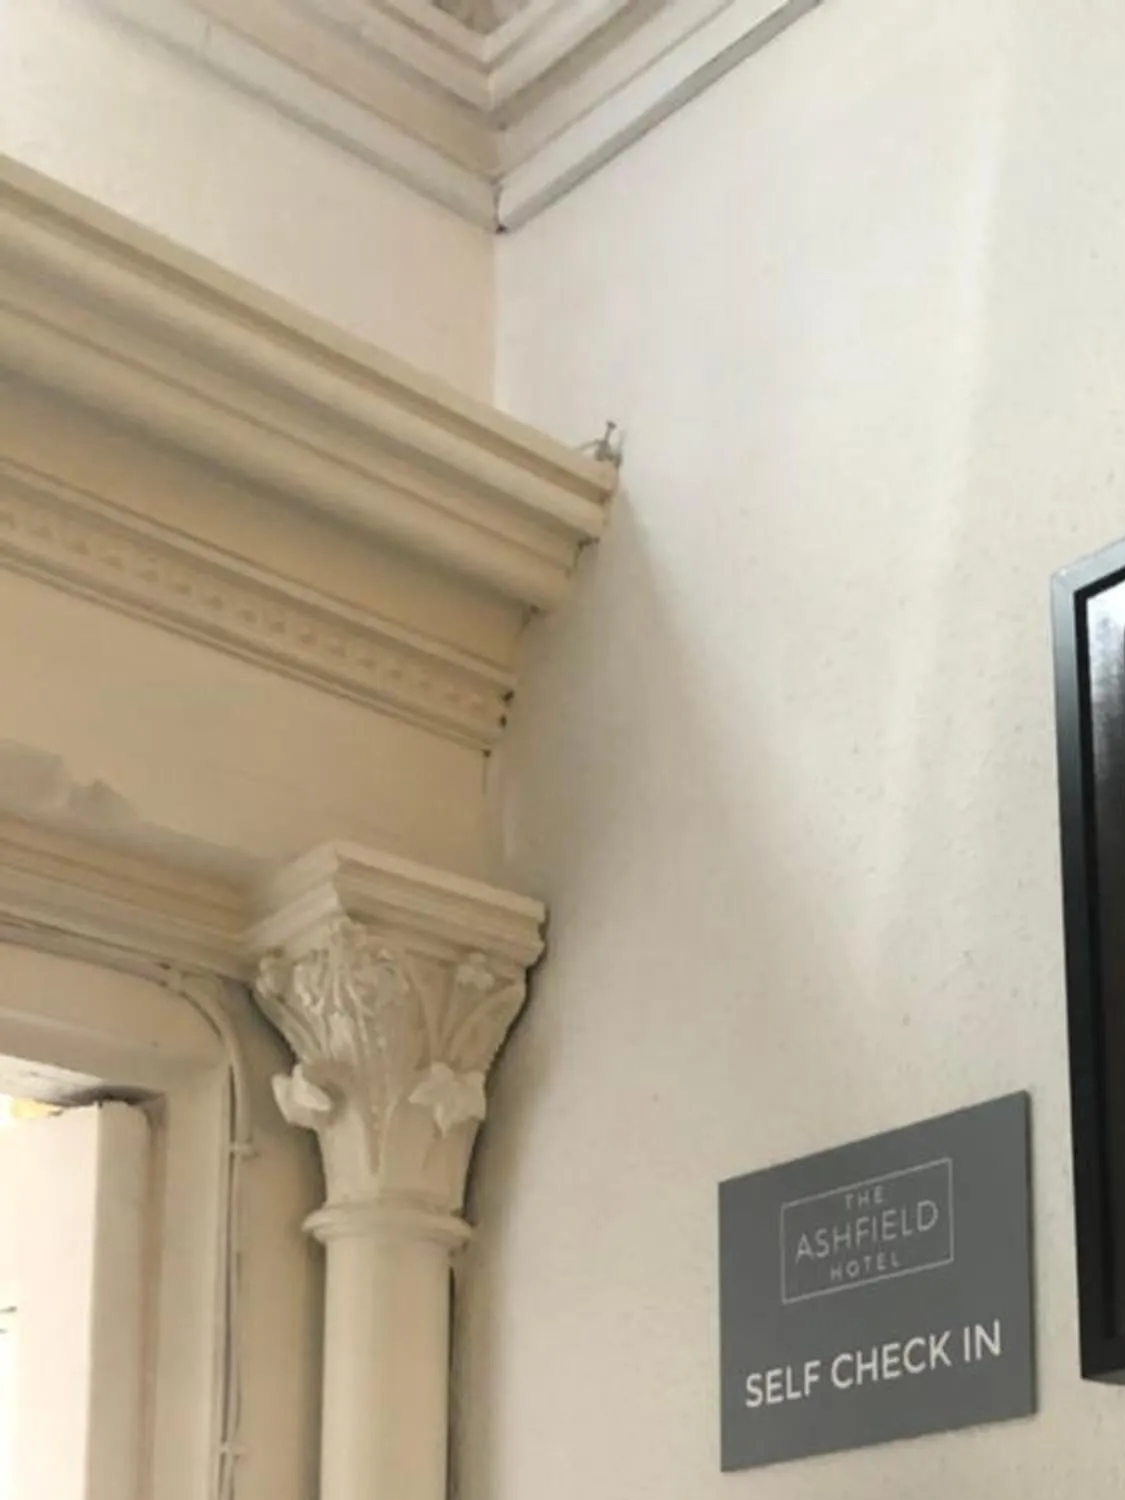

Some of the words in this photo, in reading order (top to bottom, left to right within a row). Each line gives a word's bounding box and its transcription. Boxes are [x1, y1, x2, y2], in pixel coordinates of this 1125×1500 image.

[845, 1186, 884, 1210] THE
[796, 1200, 939, 1263] ASHFIELD
[831, 1253, 902, 1281] HOTEL
[745, 1360, 821, 1408] SELF
[831, 1330, 952, 1389] CHECK
[963, 1319, 1001, 1363] IN
